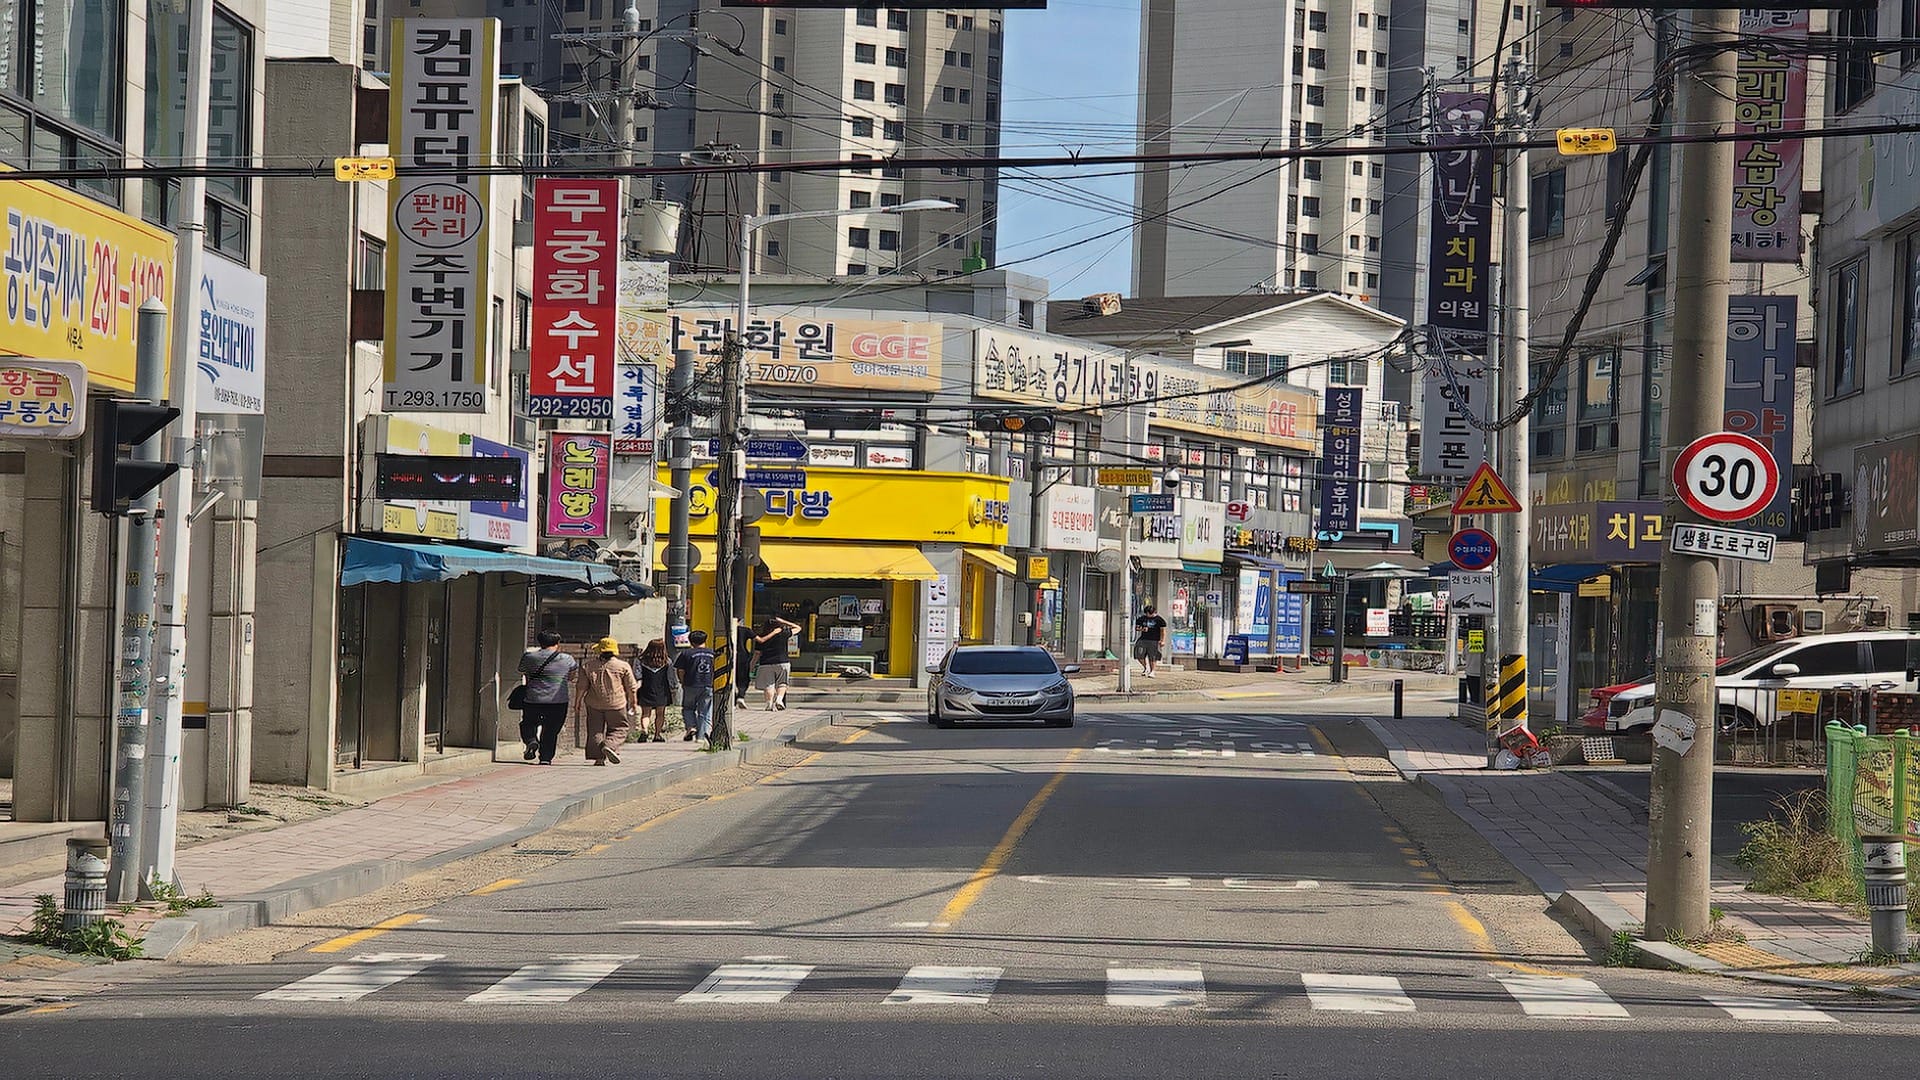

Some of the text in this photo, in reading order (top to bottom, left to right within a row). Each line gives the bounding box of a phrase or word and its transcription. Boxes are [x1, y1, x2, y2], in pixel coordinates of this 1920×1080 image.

[410, 28, 474, 184] 컴퓨터
[412, 193, 467, 215] 판매
[411, 218, 466, 238] 수리
[545, 188, 607, 304] 무궁화
[5, 212, 87, 330] 공인중개사
[408, 253, 470, 382] 주변기기
[1438, 300, 1480, 318] 의원
[200, 309, 255, 373] 홈인테리어
[547, 311, 599, 394] 수선
[852, 334, 930, 360] GGE
[2, 371, 62, 397] 황금
[1053, 350, 1158, 407] 경기사관학원
[386, 390, 482, 408] T.293.1750
[531, 397, 612, 416] 292-2950
[1268, 401, 1297, 437] GGE
[562, 441, 597, 519] 노래방
[1331, 438, 1351, 518] 이비인후과
[1700, 454, 1756, 500] 30
[1228, 503, 1249, 521] 약
[1328, 520, 1349, 530] 의원
[1537, 513, 1590, 551] 가나수치과
[1681, 532, 1770, 556] 생활도로구역
[1451, 575, 1492, 585] 견인지역
